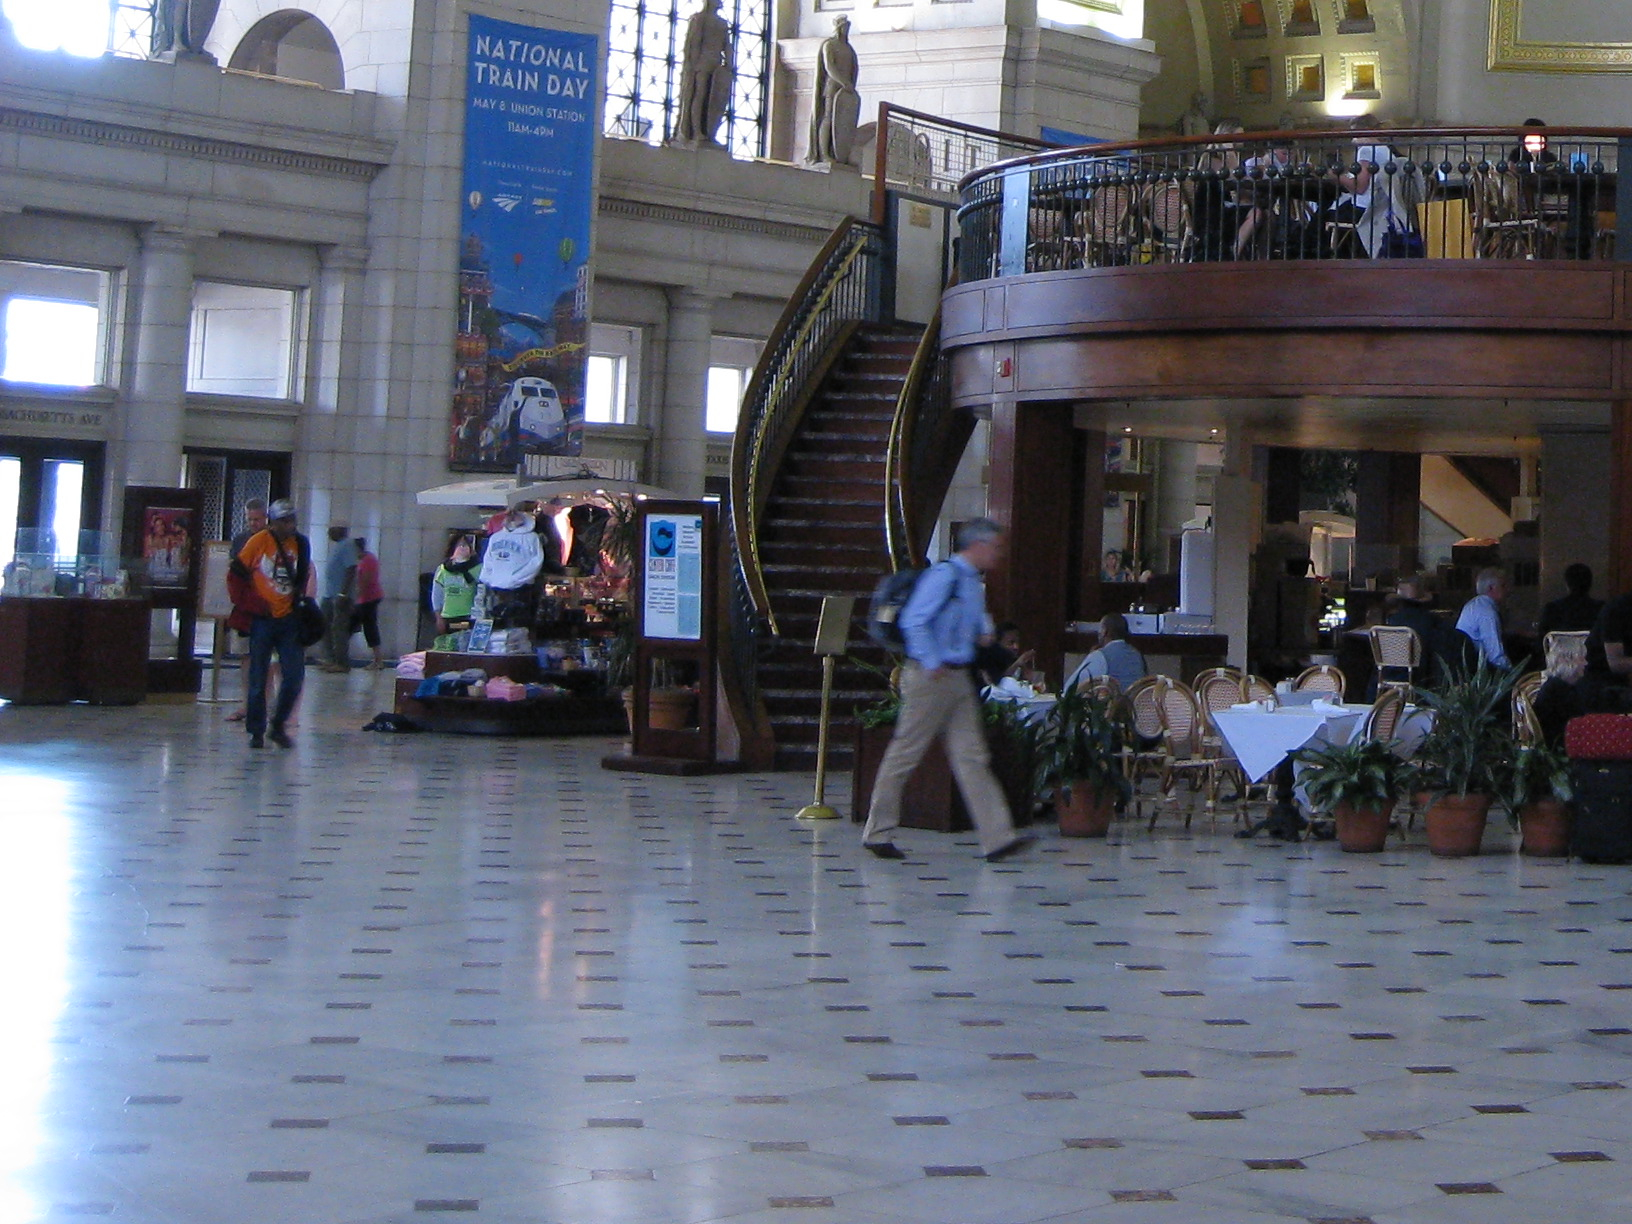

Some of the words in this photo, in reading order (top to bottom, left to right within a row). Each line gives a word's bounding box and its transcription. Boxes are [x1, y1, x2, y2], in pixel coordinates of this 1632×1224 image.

[476, 34, 589, 73] NATIONAL
[474, 61, 539, 92] TRAIN
[546, 74, 589, 100] DAY
[473, 97, 497, 109] MAY
[511, 102, 544, 117] UNION
[546, 107, 586, 122] STATION
[508, 120, 554, 137] 11AM-4PM
